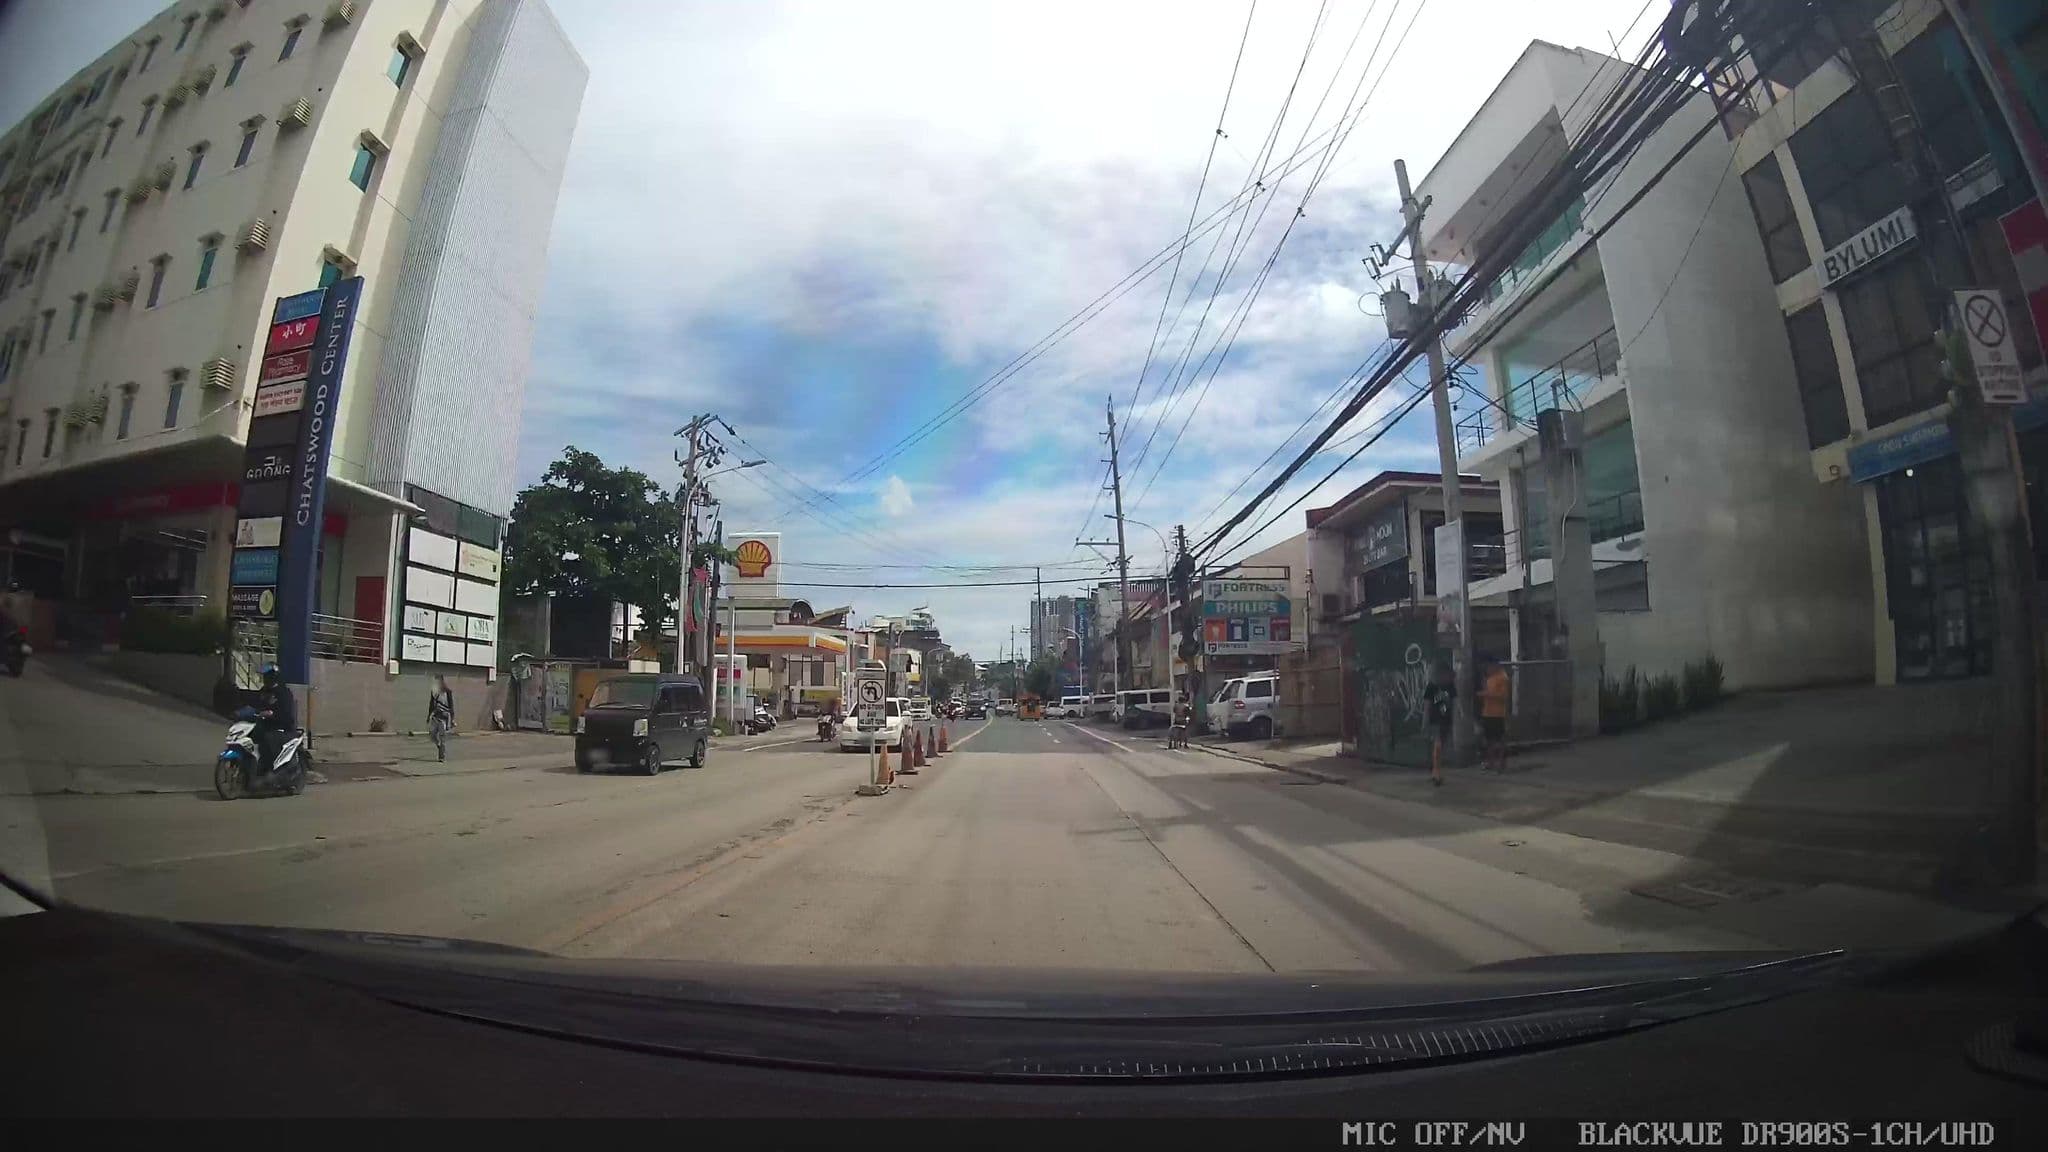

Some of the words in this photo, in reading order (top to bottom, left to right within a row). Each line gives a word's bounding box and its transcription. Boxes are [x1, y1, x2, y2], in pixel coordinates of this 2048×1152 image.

[1823, 216, 1907, 280] BYLUMI
[297, 385, 328, 527] CHATSWOOD
[321, 296, 349, 375] CENTER
[1223, 583, 1286, 592] FORTRESS
[1216, 601, 1278, 614] PHILIPS
